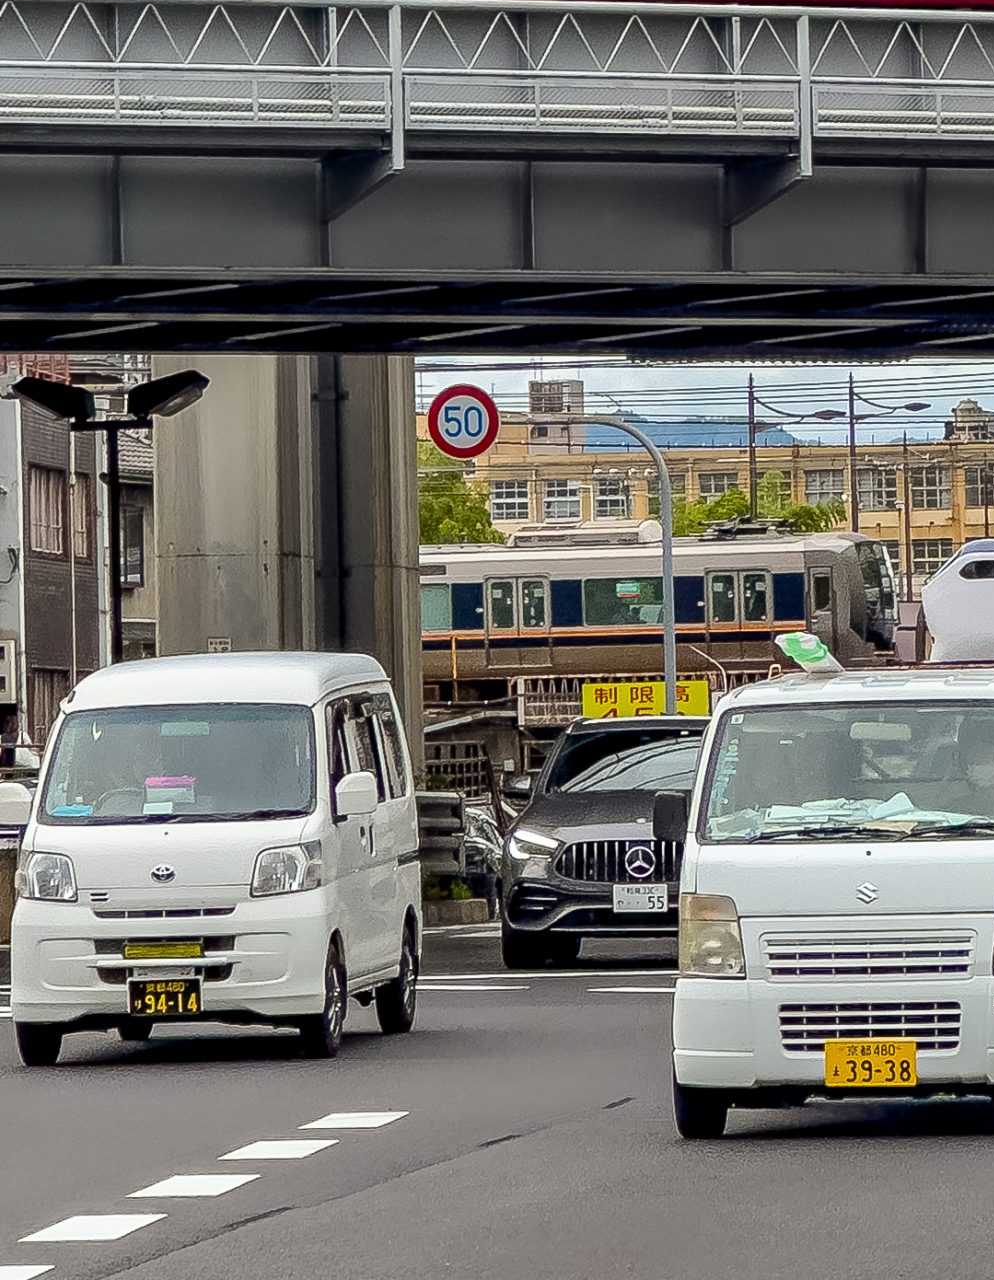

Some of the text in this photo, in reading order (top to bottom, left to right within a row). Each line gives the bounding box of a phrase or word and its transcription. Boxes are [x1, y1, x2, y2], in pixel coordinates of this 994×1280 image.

[444, 406, 483, 438] 50
[145, 993, 198, 1014] 94-14
[846, 1044, 896, 1057] 京都480
[845, 1059, 912, 1083] 39-38
